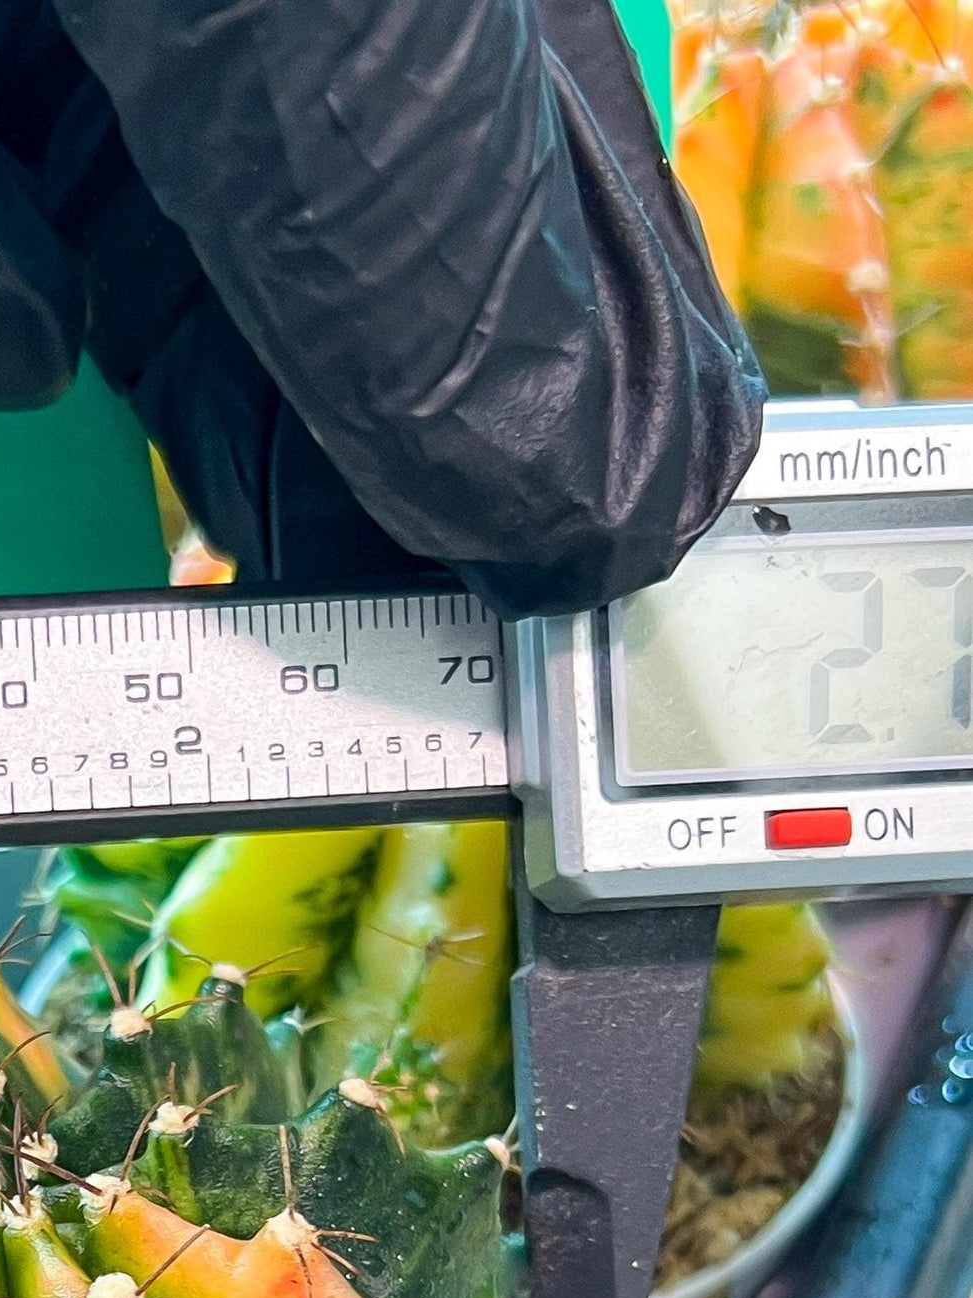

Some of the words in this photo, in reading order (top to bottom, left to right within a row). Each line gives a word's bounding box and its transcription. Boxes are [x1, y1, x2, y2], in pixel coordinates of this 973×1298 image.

[779, 436, 946, 482] mm/inch
[123, 672, 183, 704] 50
[280, 663, 340, 695] 60
[438, 655, 494, 686] 70
[31, 756, 49, 775] 6
[74, 753, 89, 772] 7
[109, 752, 129, 770] 8
[149, 749, 168, 769] 9
[173, 725, 203, 756] 2
[268, 742, 286, 762] 2
[307, 740, 325, 758] 3
[346, 738, 363, 756] 4
[386, 735, 402, 755] 5
[425, 733, 442, 753] 6
[468, 731, 483, 750] 7
[667, 815, 738, 851] OFF
[864, 806, 915, 842] ON
